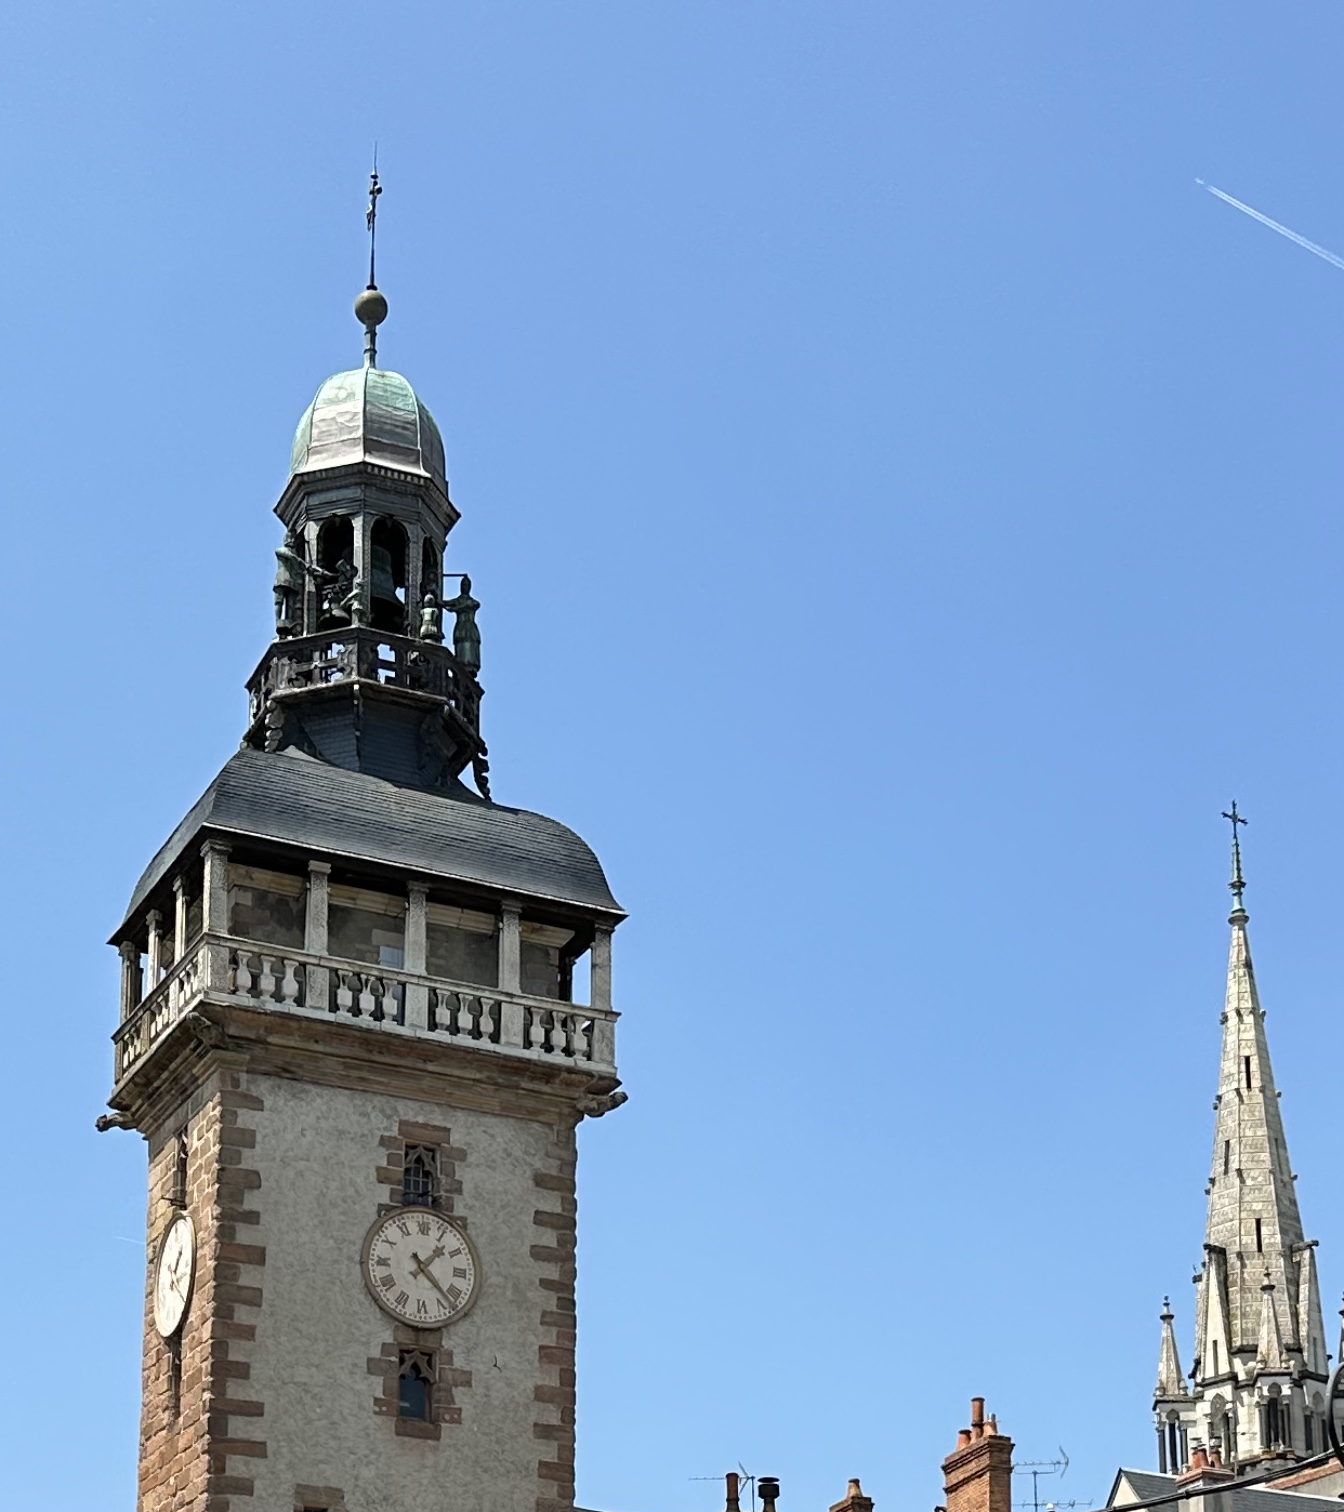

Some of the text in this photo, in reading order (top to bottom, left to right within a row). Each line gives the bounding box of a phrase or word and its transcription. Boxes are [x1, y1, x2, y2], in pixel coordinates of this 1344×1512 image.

[381, 1233, 397, 1248] X
[448, 1247, 462, 1259] II
[453, 1266, 467, 1280] III
[436, 1298, 448, 1314] V
